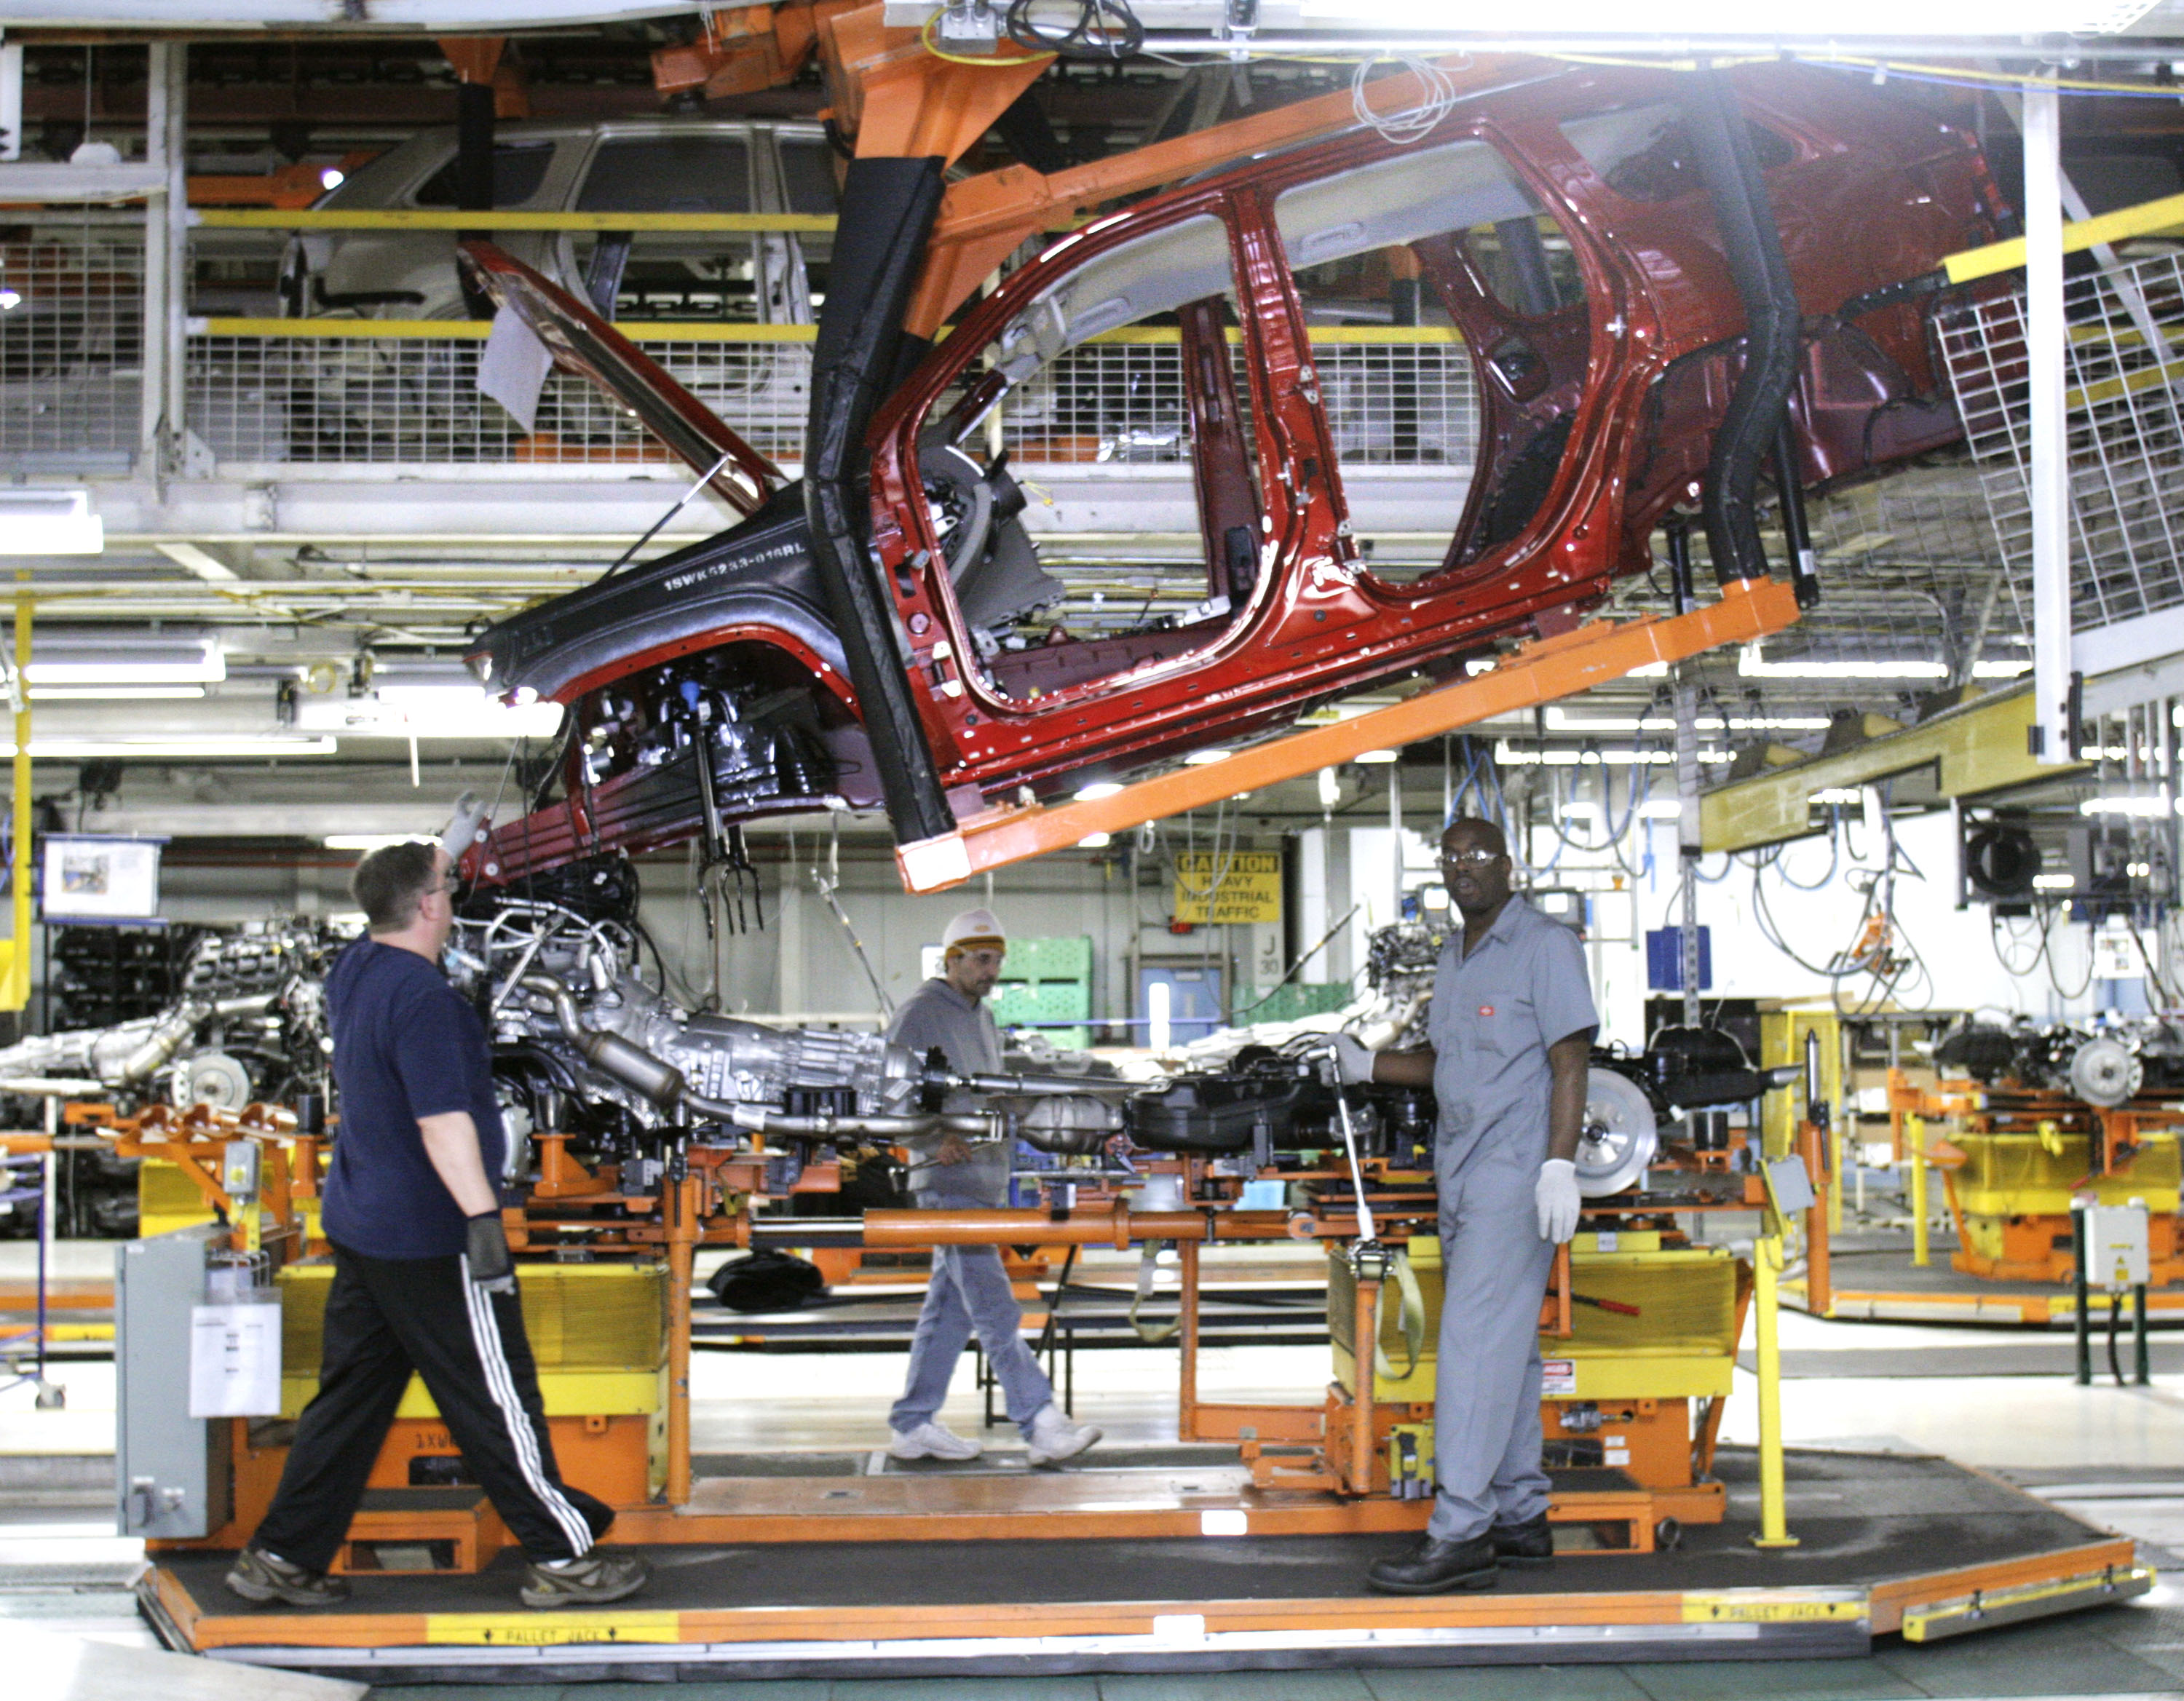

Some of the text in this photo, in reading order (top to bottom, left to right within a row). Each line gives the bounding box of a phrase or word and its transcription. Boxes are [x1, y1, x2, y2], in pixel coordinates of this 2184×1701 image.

[1202, 876, 1253, 887] HAVY
[506, 1629, 599, 1643] PALLET JACK
